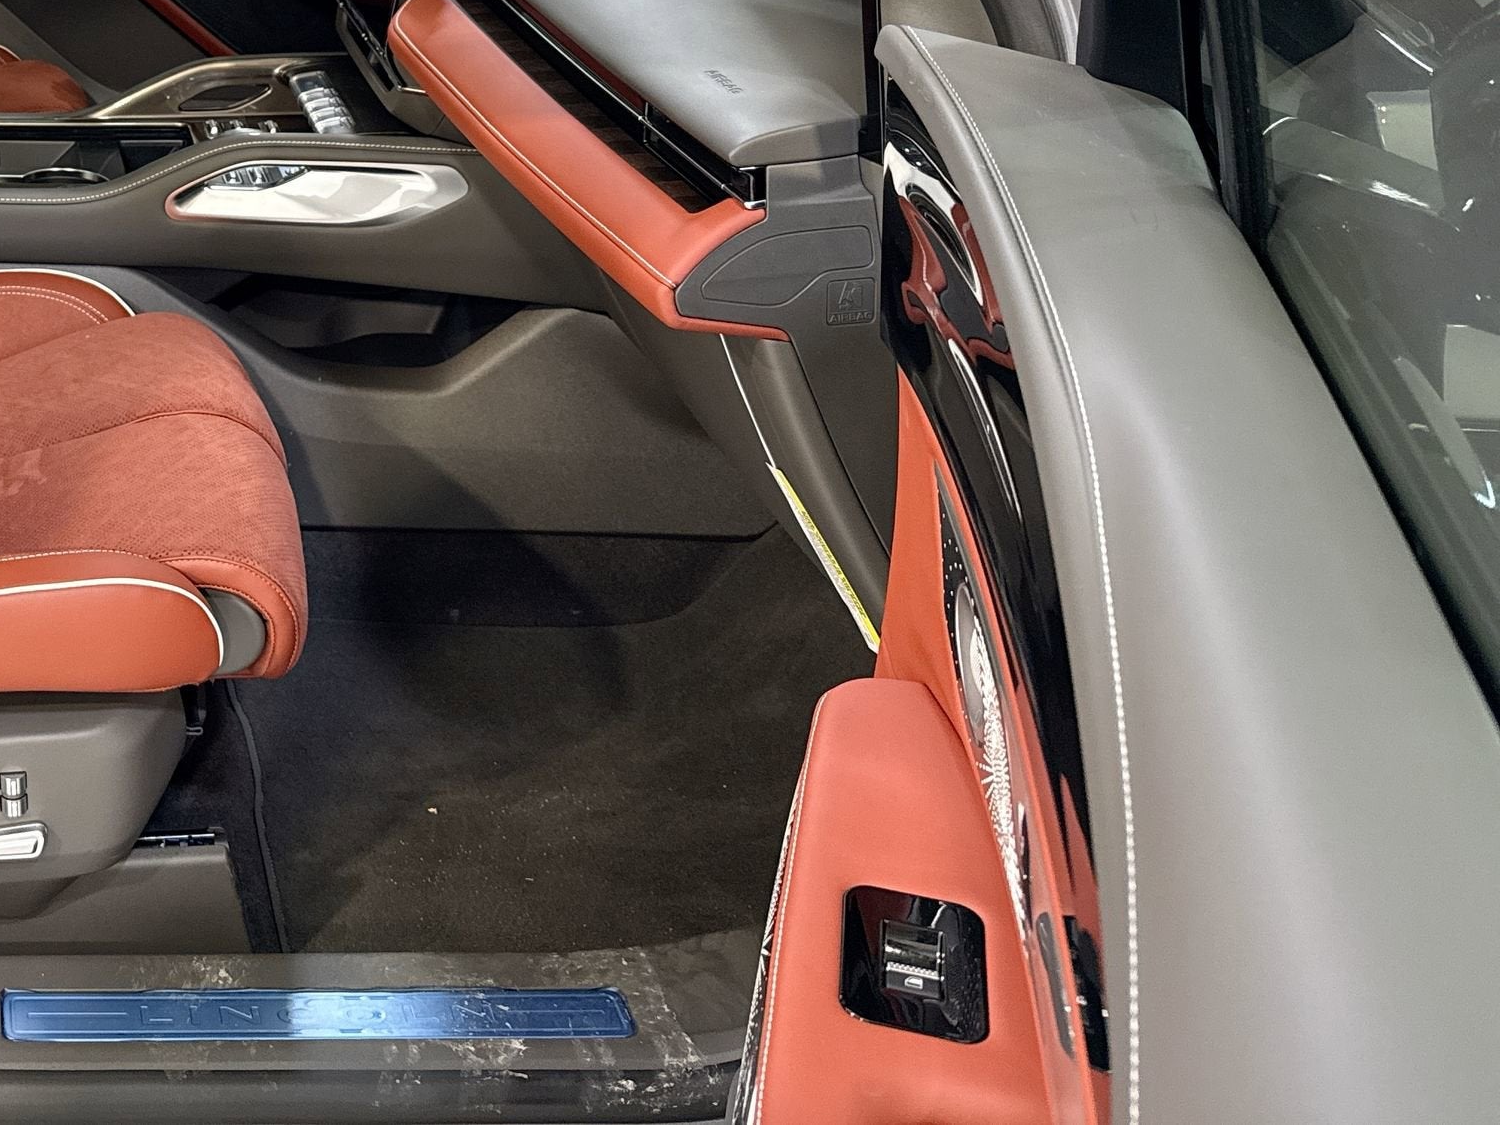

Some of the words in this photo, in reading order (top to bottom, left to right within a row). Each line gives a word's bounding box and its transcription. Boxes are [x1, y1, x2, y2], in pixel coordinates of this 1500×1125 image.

[703, 69, 744, 94] AIRBAG
[829, 312, 871, 324] AIRBAG
[140, 1000, 498, 1025] LINCOLN
